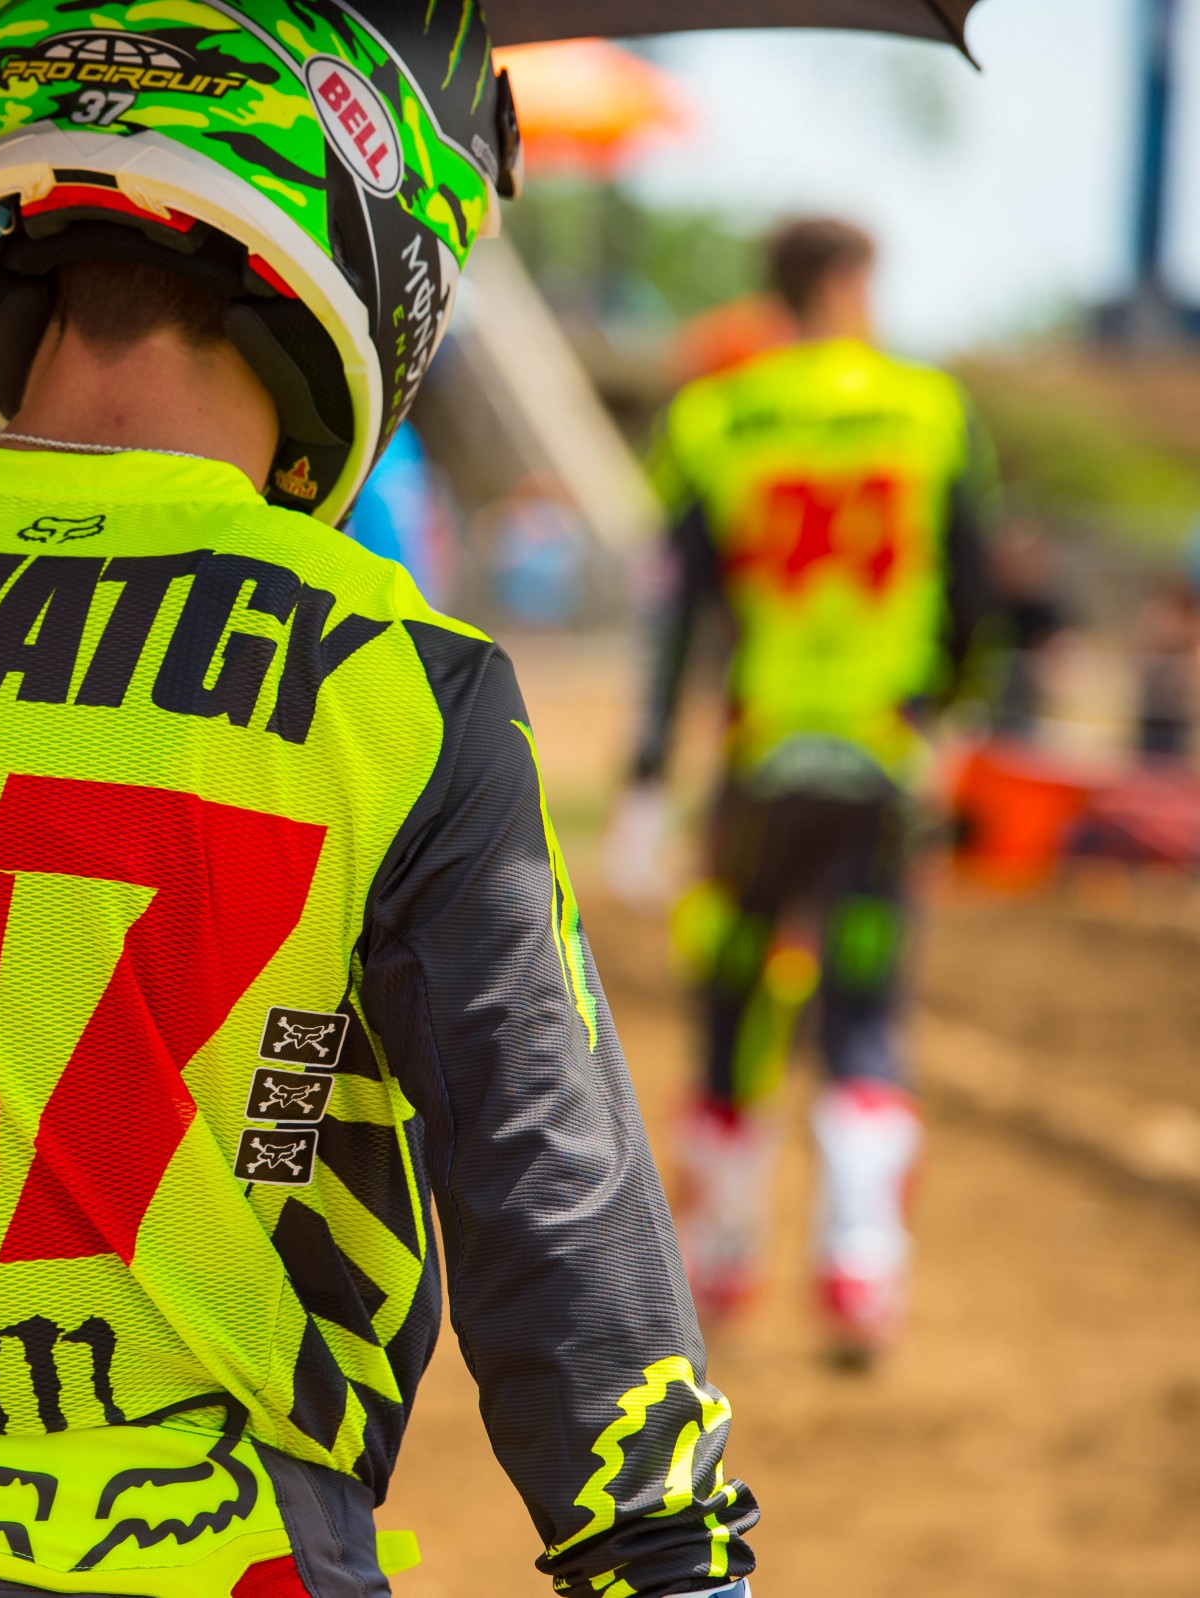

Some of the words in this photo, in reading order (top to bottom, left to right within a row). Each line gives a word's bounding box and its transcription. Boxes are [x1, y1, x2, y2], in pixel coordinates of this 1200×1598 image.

[2, 60, 75, 83] PRO
[77, 63, 241, 96] CIRCUIT
[70, 90, 136, 126] 37
[318, 71, 389, 180] BELL
